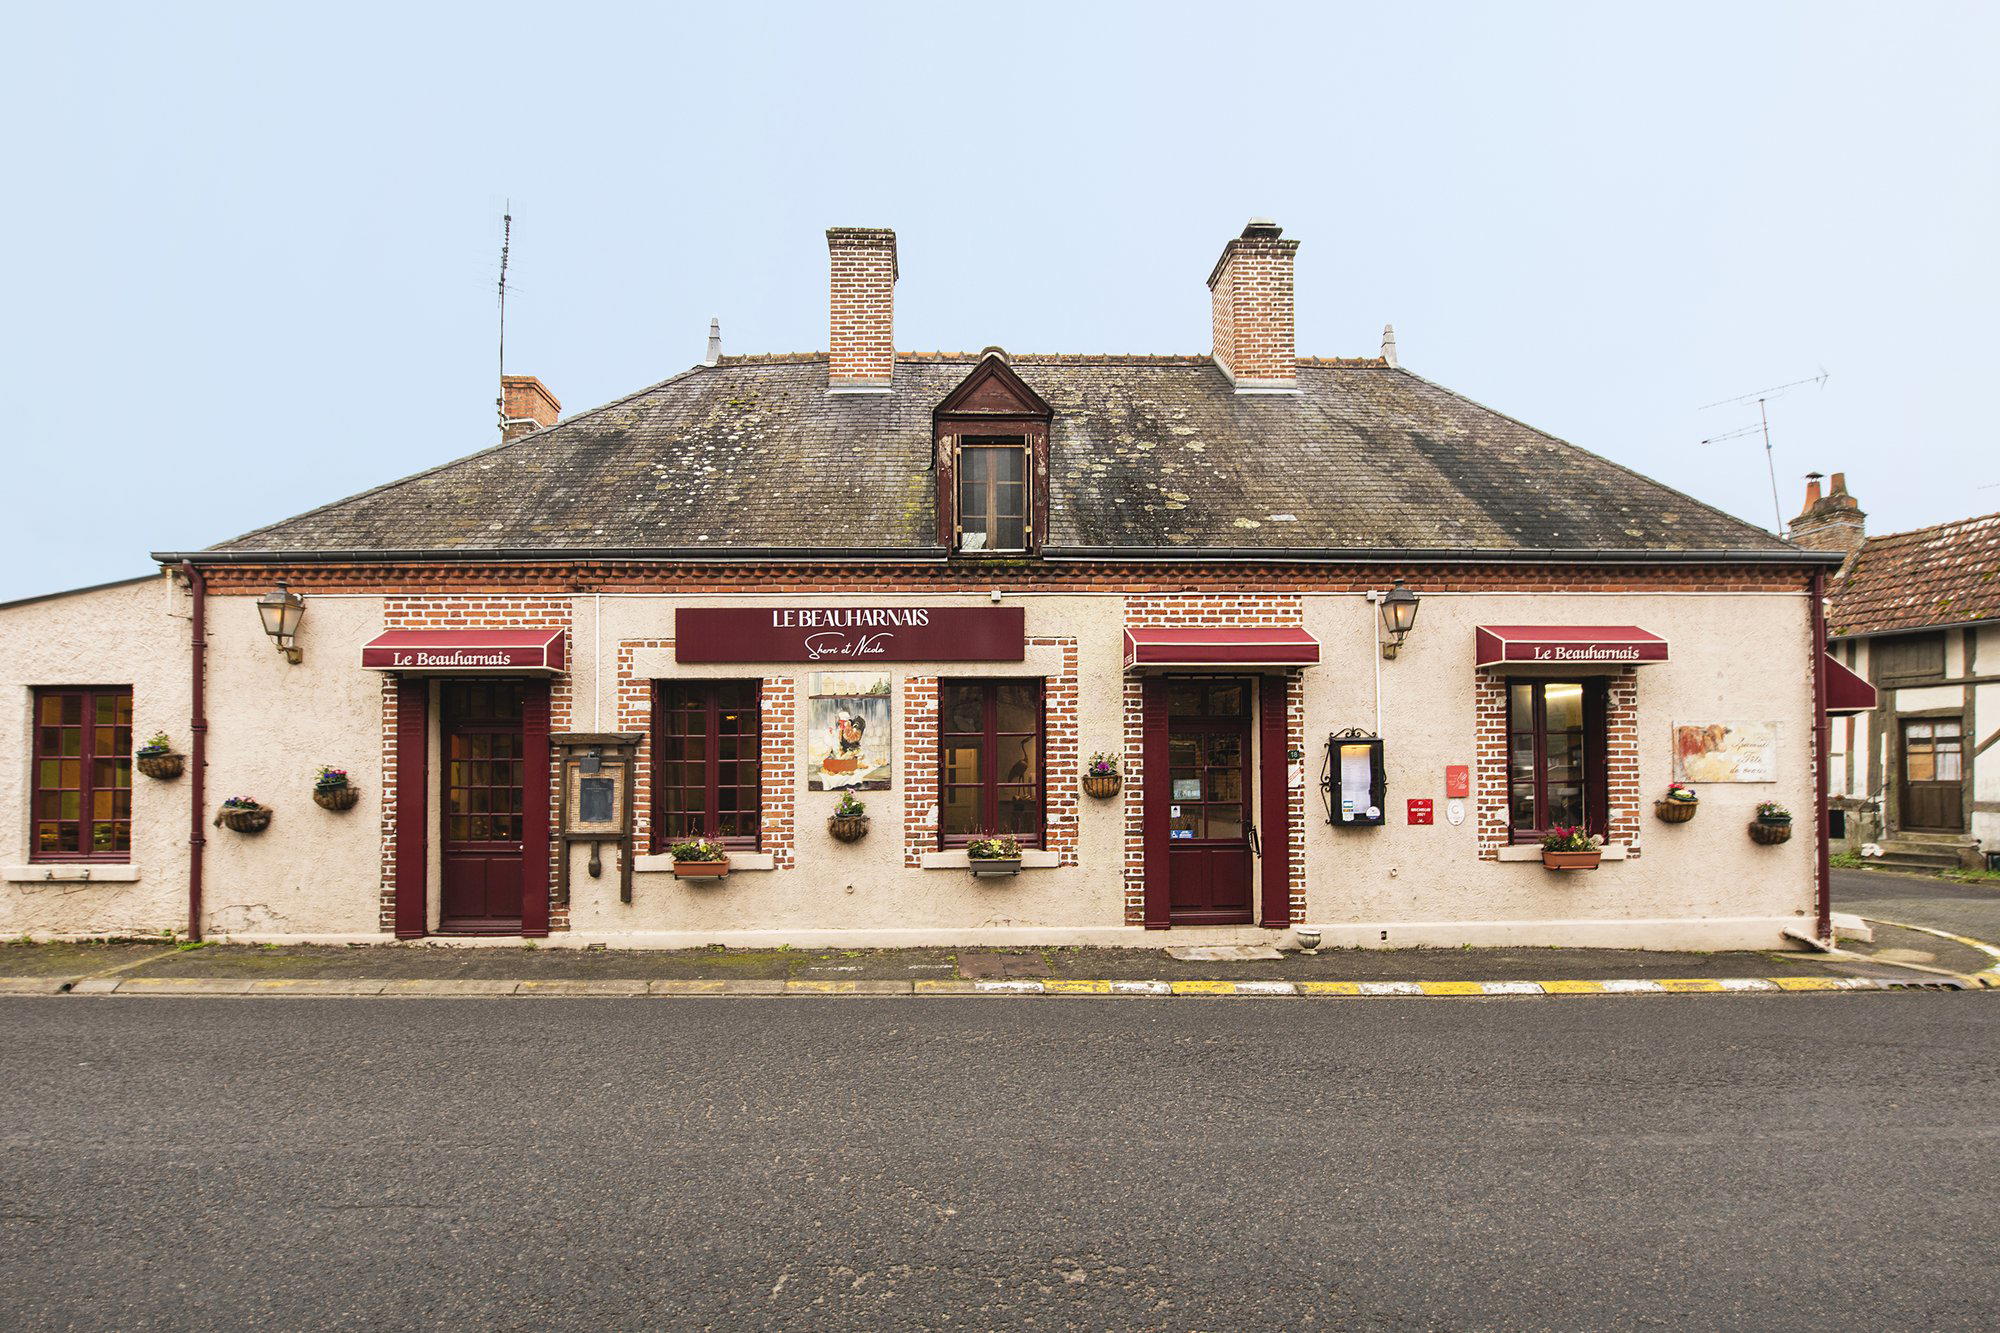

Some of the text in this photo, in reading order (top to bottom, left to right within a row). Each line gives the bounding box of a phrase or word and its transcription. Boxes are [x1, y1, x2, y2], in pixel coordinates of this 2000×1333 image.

[772, 608, 930, 628] LE BEAUHARNAIS
[841, 642, 851, 655] et
[851, 632, 894, 657] Nicola
[1534, 644, 1640, 660] Le Beauharnais
[393, 650, 511, 666] Le Beauharnais
